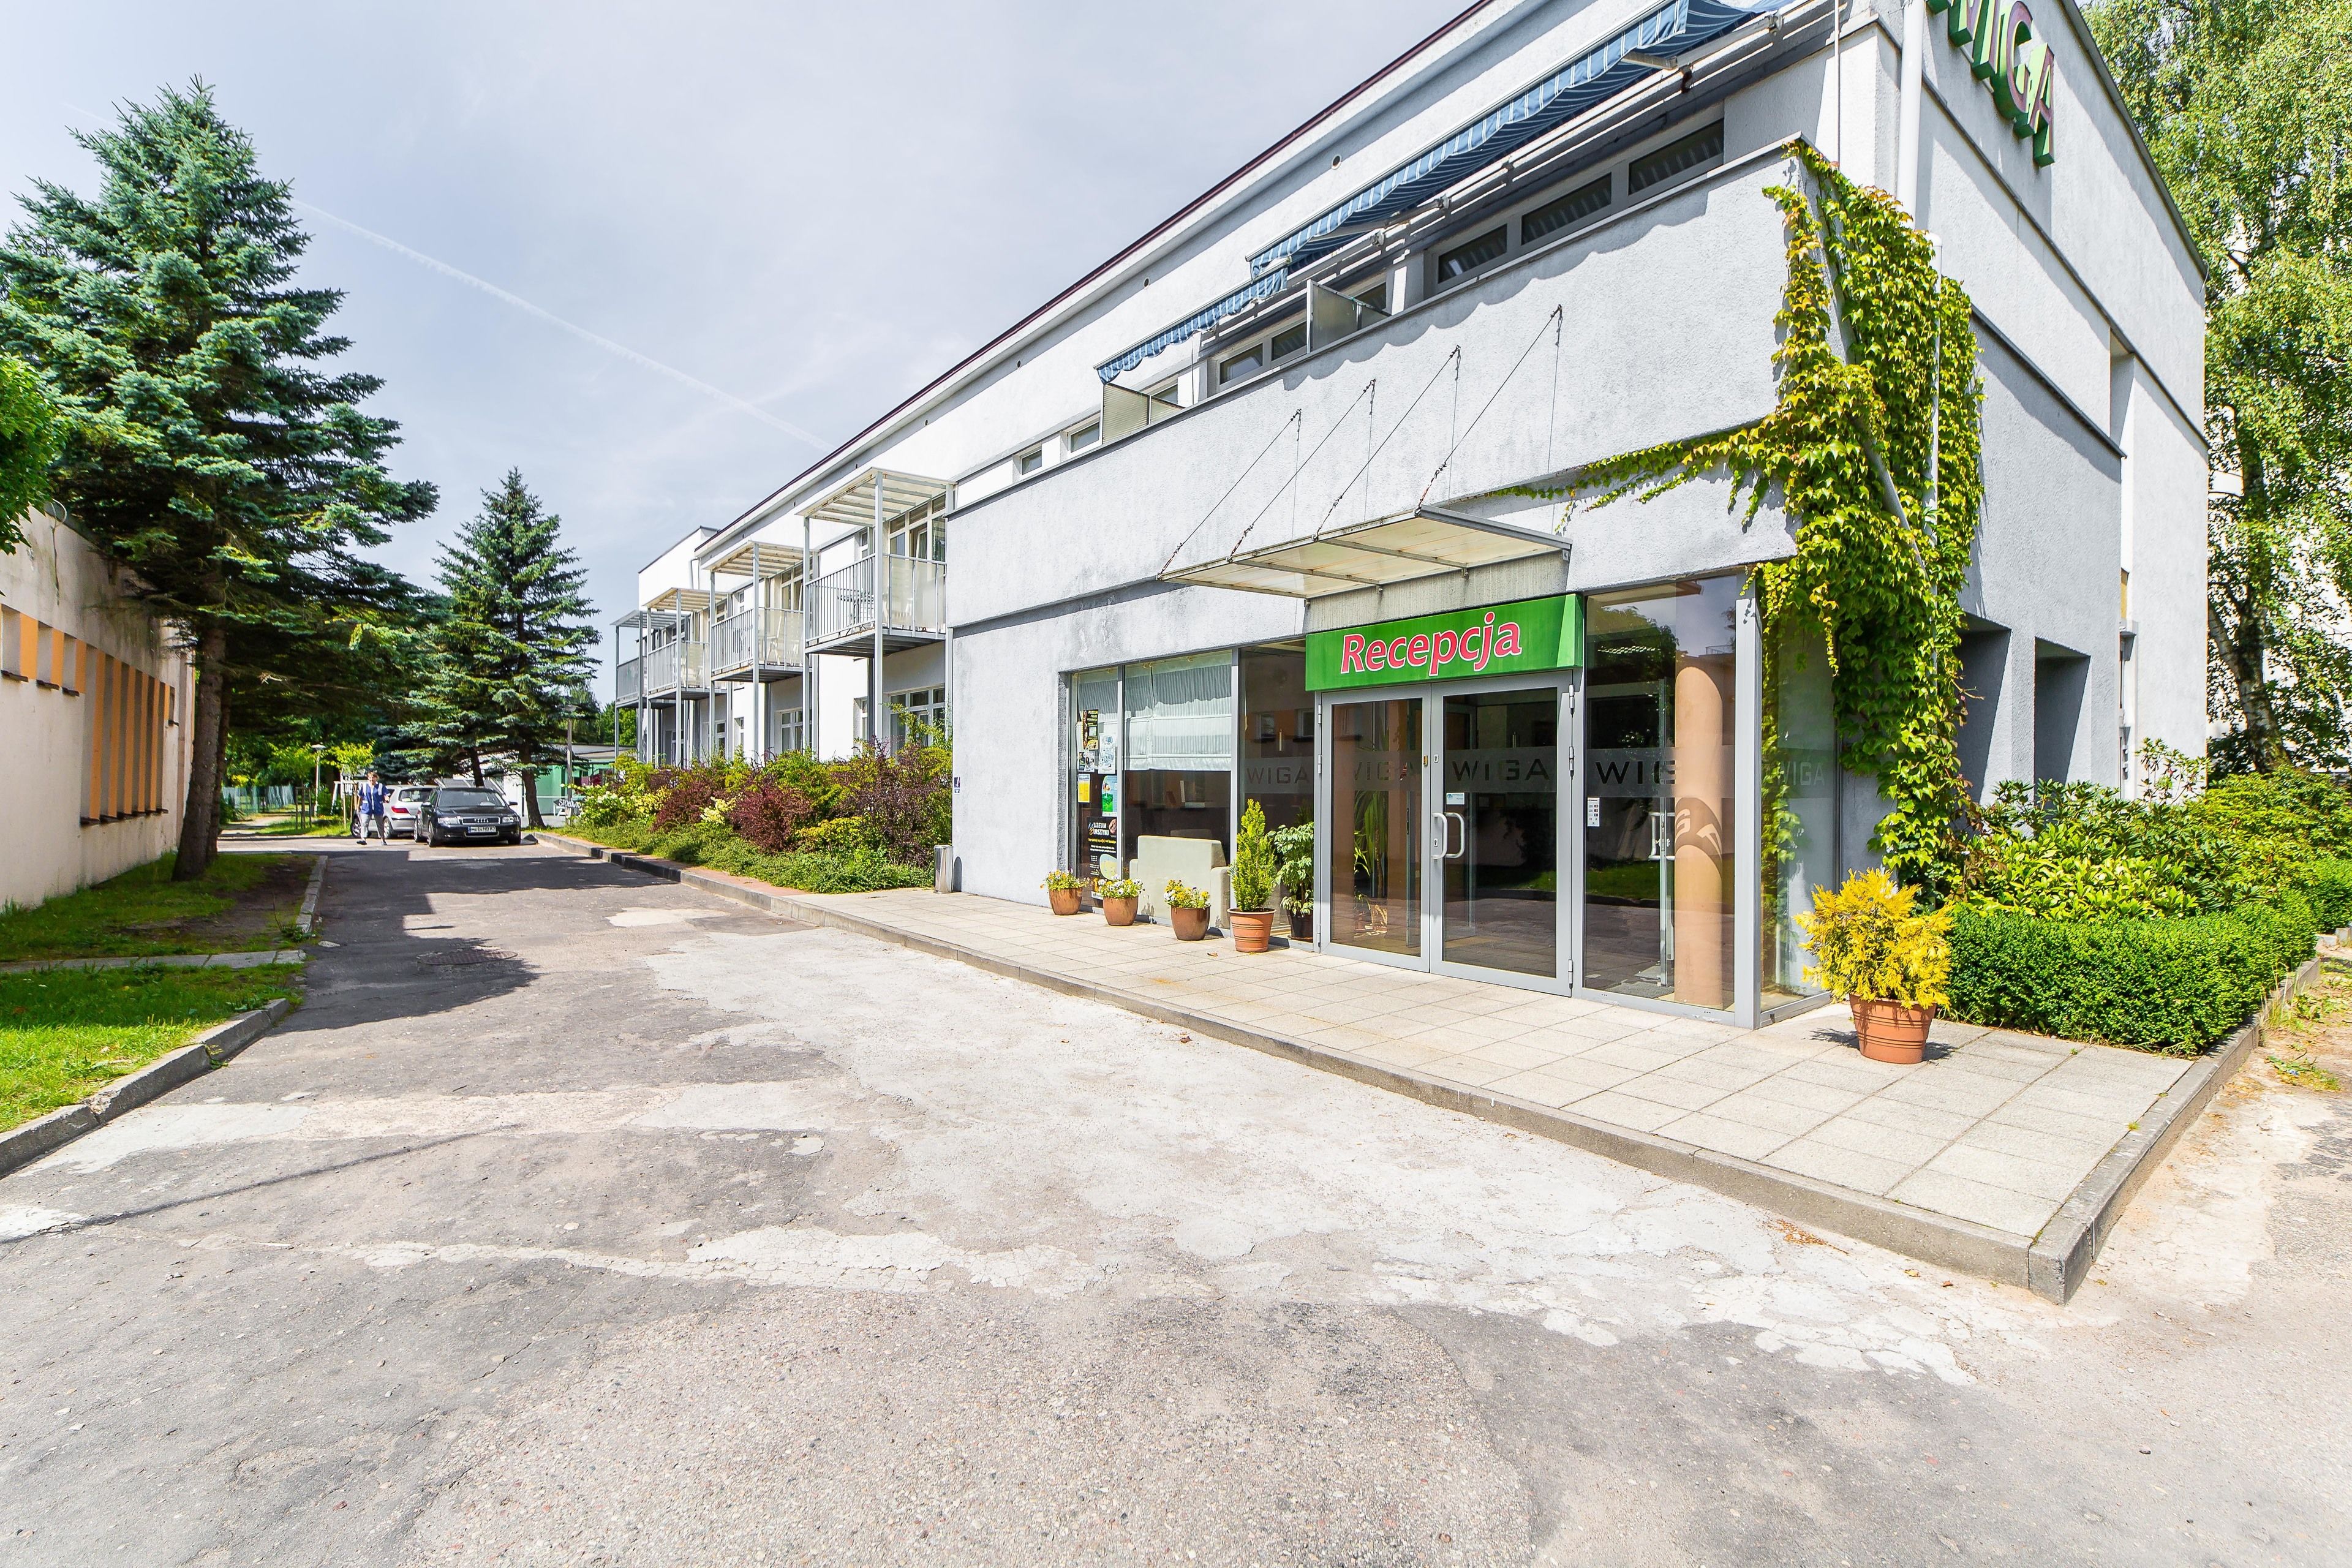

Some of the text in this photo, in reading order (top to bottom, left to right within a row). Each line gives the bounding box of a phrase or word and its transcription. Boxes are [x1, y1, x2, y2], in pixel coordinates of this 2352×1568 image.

[1340, 611, 1522, 677] Recepcja
[1246, 766, 1310, 785] WIGA
[1354, 761, 1414, 781] IGA
[1452, 758, 1550, 782] WIGA
[1595, 760, 1676, 785] WIG
